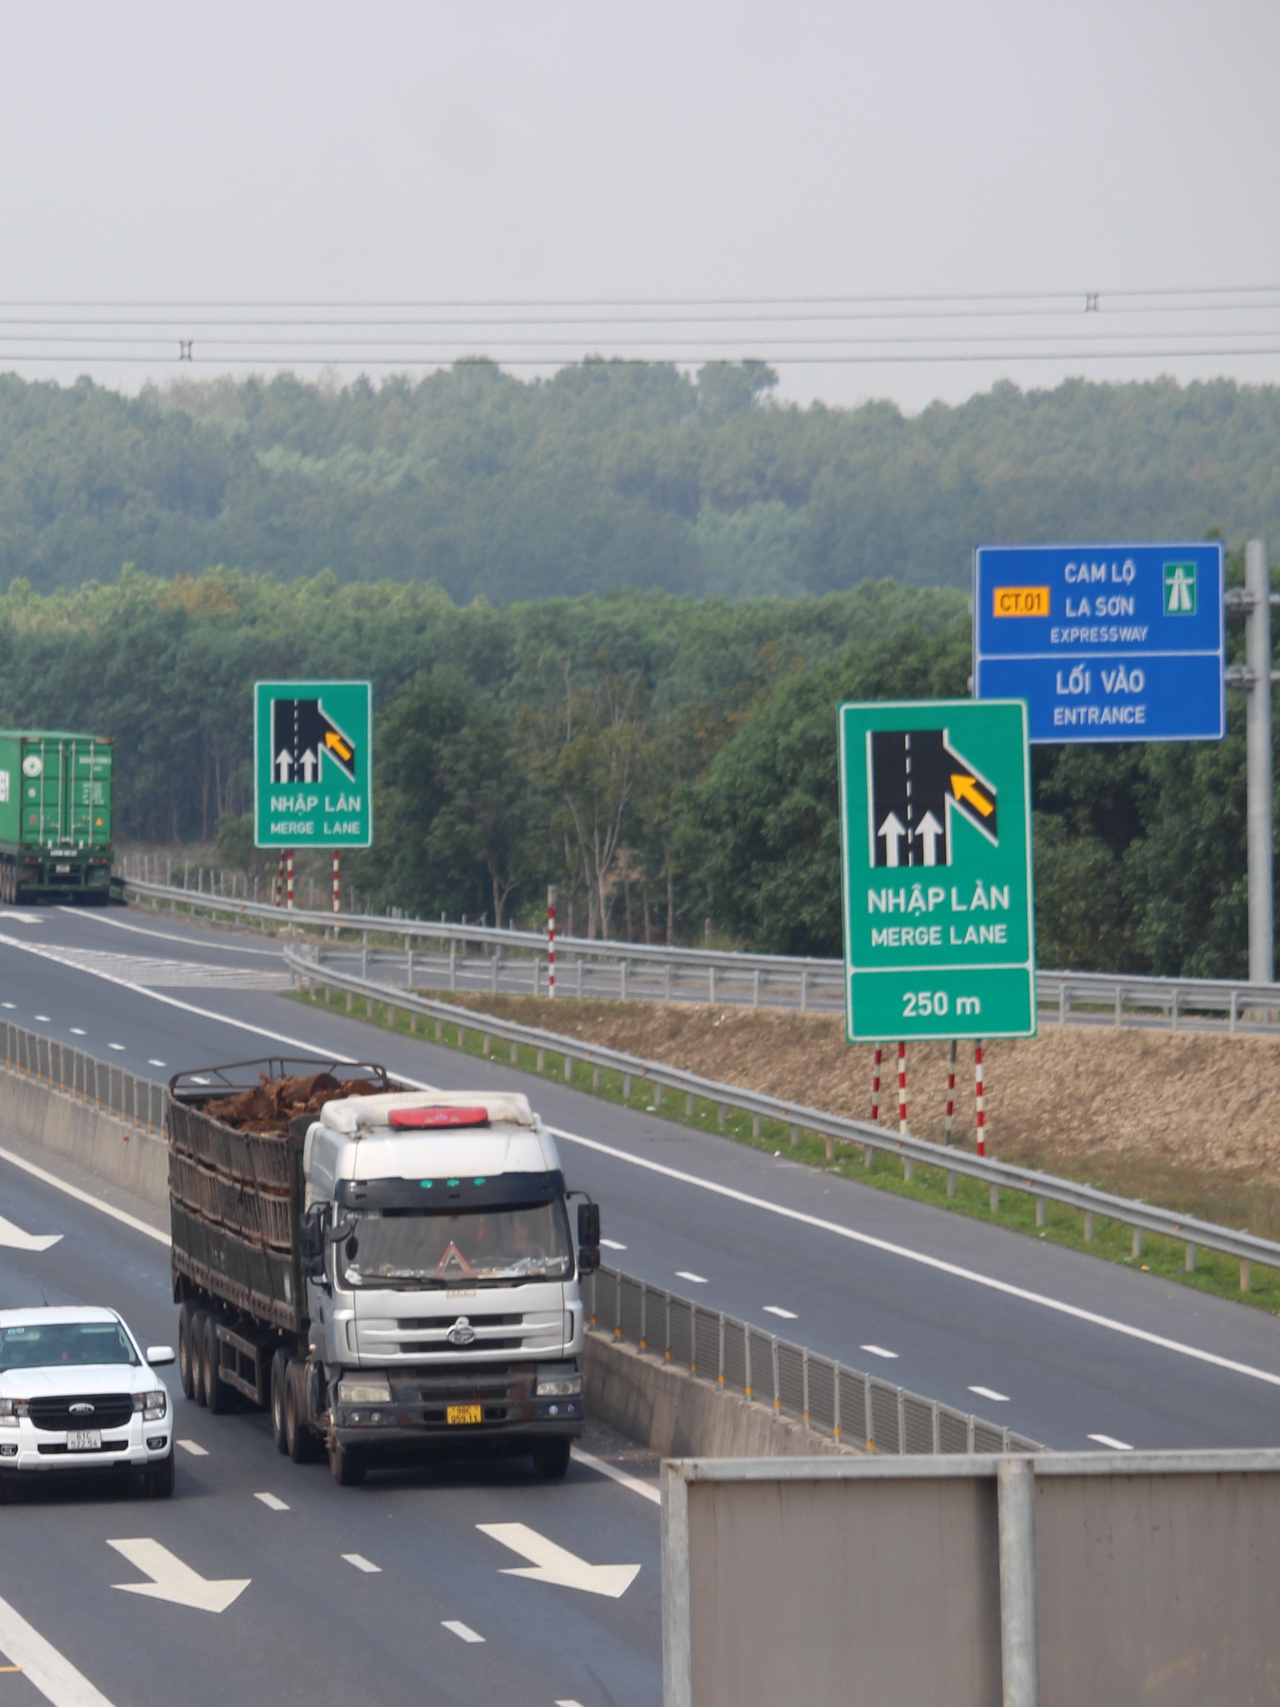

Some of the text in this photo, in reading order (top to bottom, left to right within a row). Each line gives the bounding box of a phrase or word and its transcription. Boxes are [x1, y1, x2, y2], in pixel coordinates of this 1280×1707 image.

[1064, 558, 1136, 586] CAM LỘ
[999, 592, 1043, 613] CT.01
[1065, 596, 1135, 618] LA SƠN
[1050, 625, 1149, 644] EXPRESSWAY
[1056, 663, 1146, 695] LỐI VÀO
[1053, 705, 1147, 726] ENTRANCE
[270, 792, 362, 817] NHẬP LÀN
[270, 821, 361, 835] MERGE LANE
[867, 879, 1010, 917] NHẬP LÀN
[871, 924, 1008, 948] MERGE LANE
[901, 991, 982, 1017] 250 m
